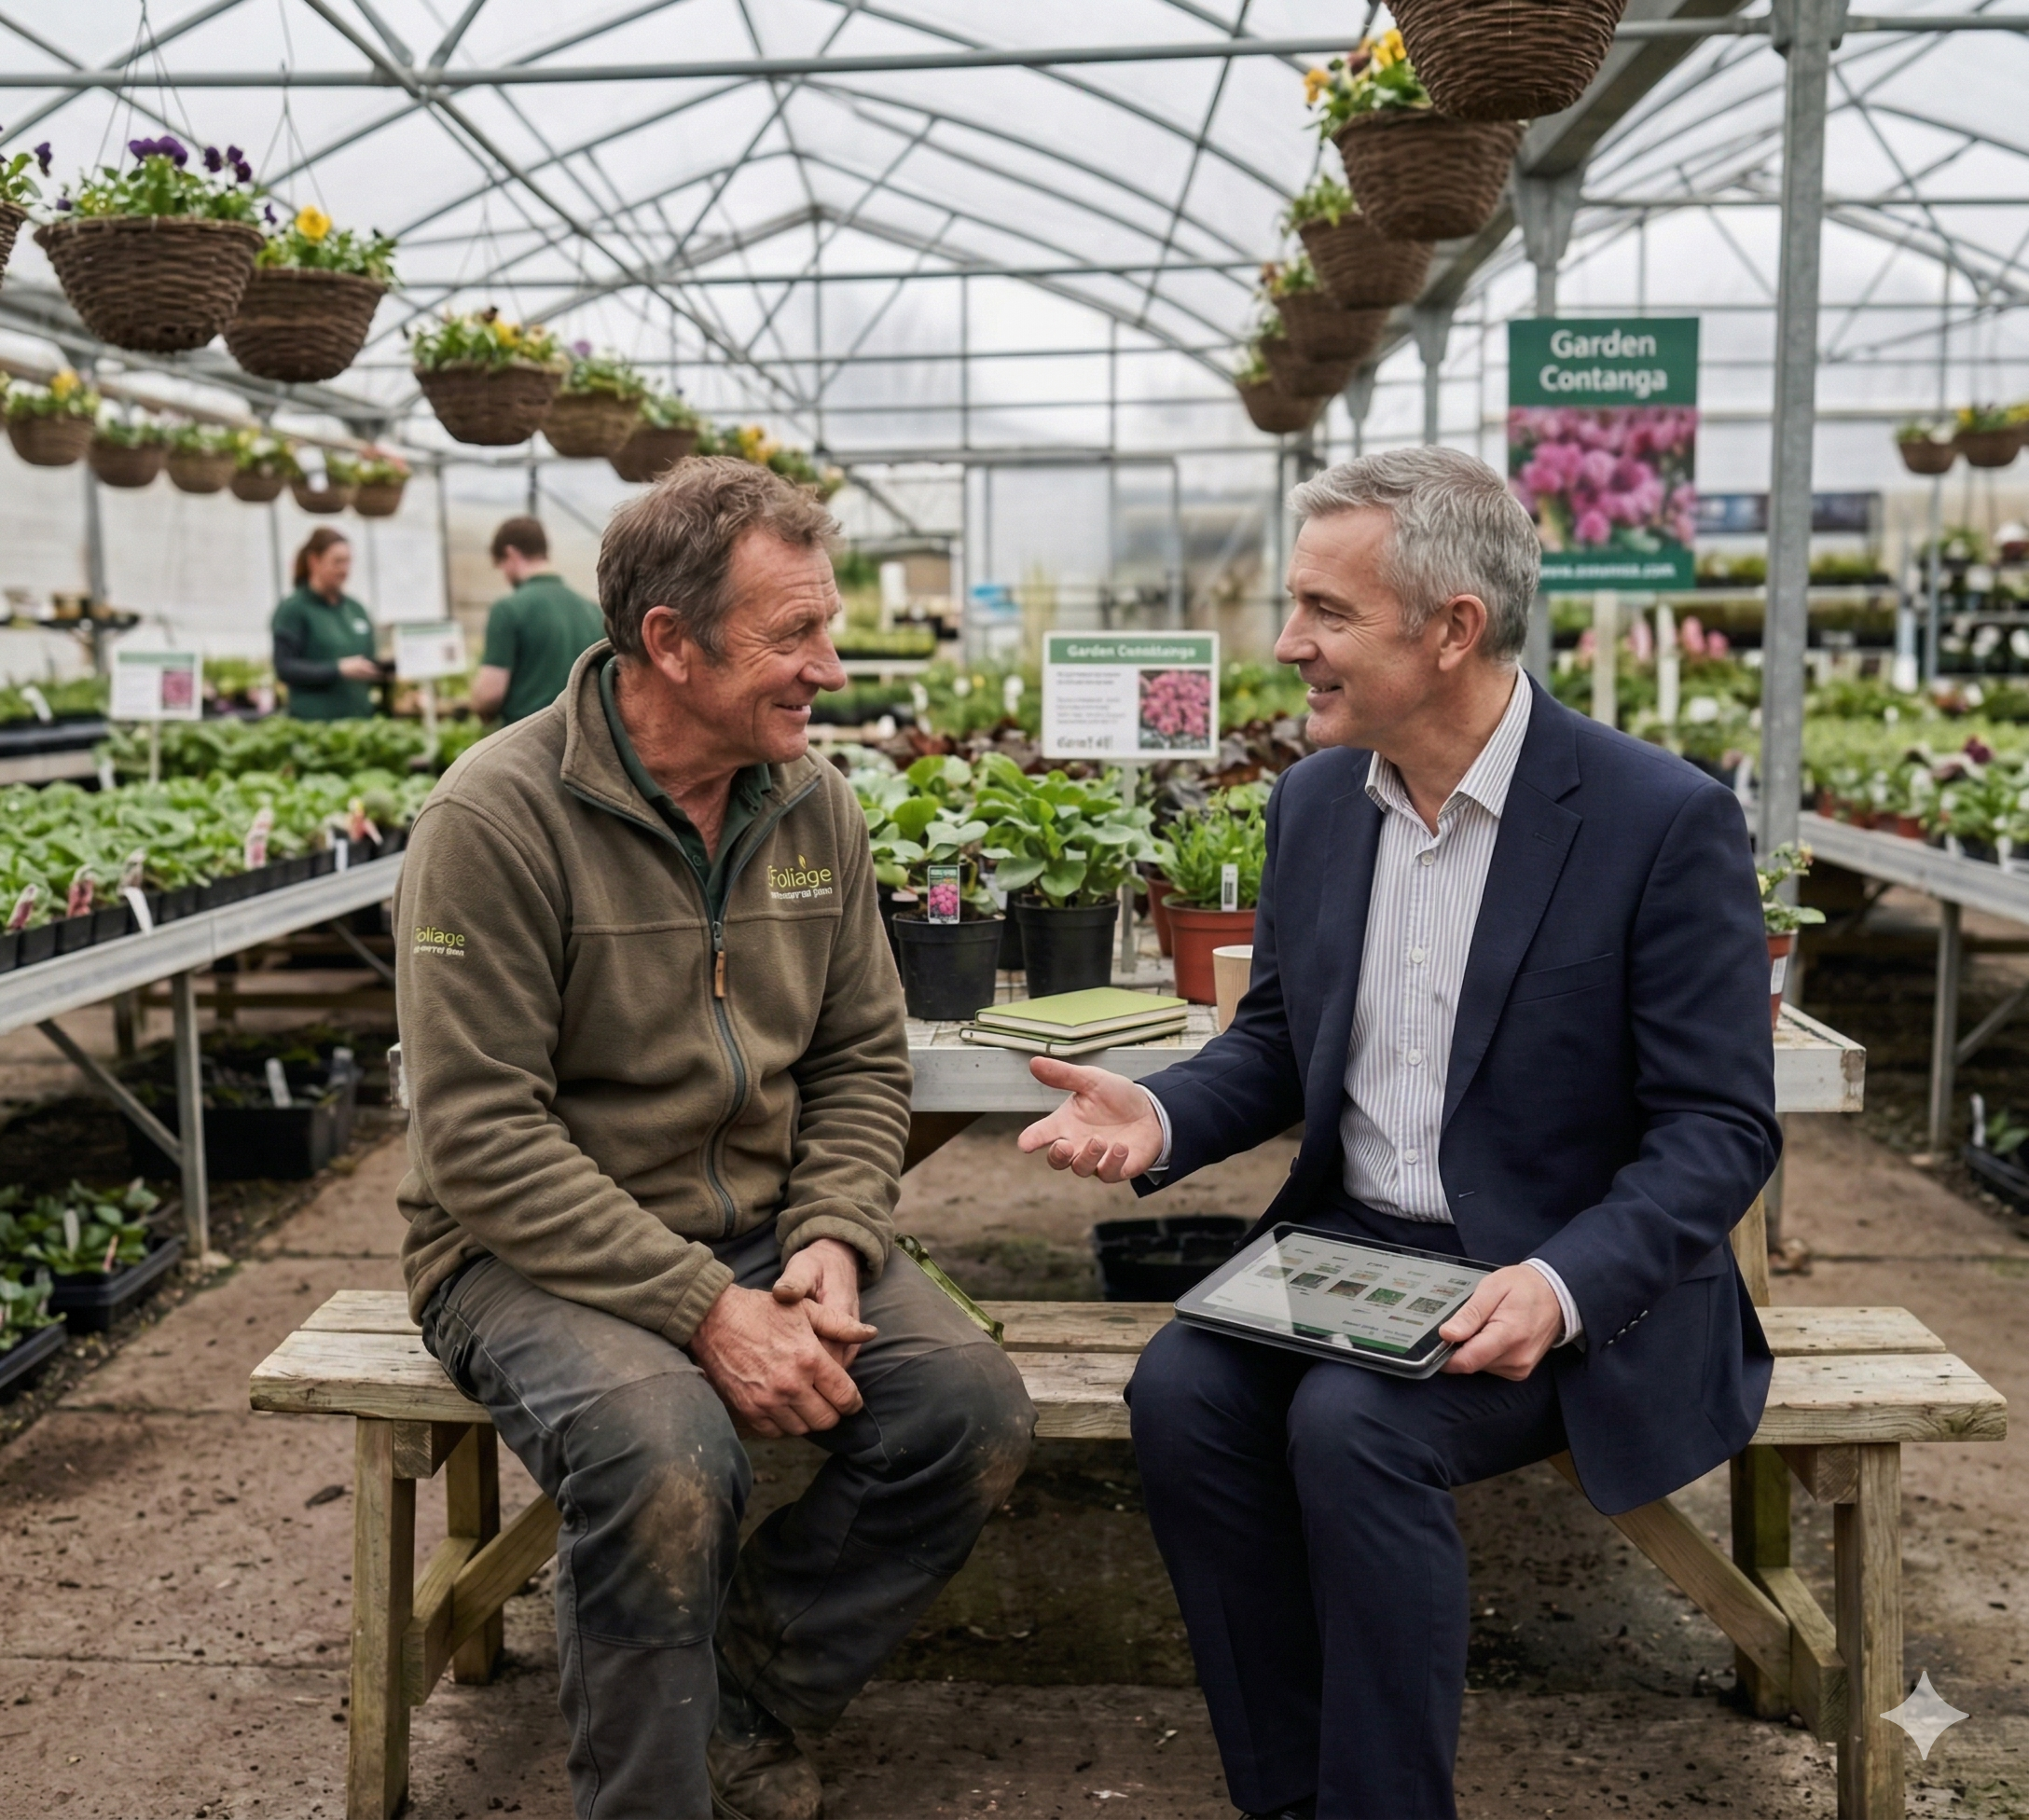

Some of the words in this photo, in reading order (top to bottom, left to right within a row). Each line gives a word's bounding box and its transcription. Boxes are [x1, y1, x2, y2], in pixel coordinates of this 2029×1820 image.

[1551, 328, 1657, 359] Garden
[1539, 365, 1667, 398] Contanga
[1067, 644, 1115, 657] Garden
